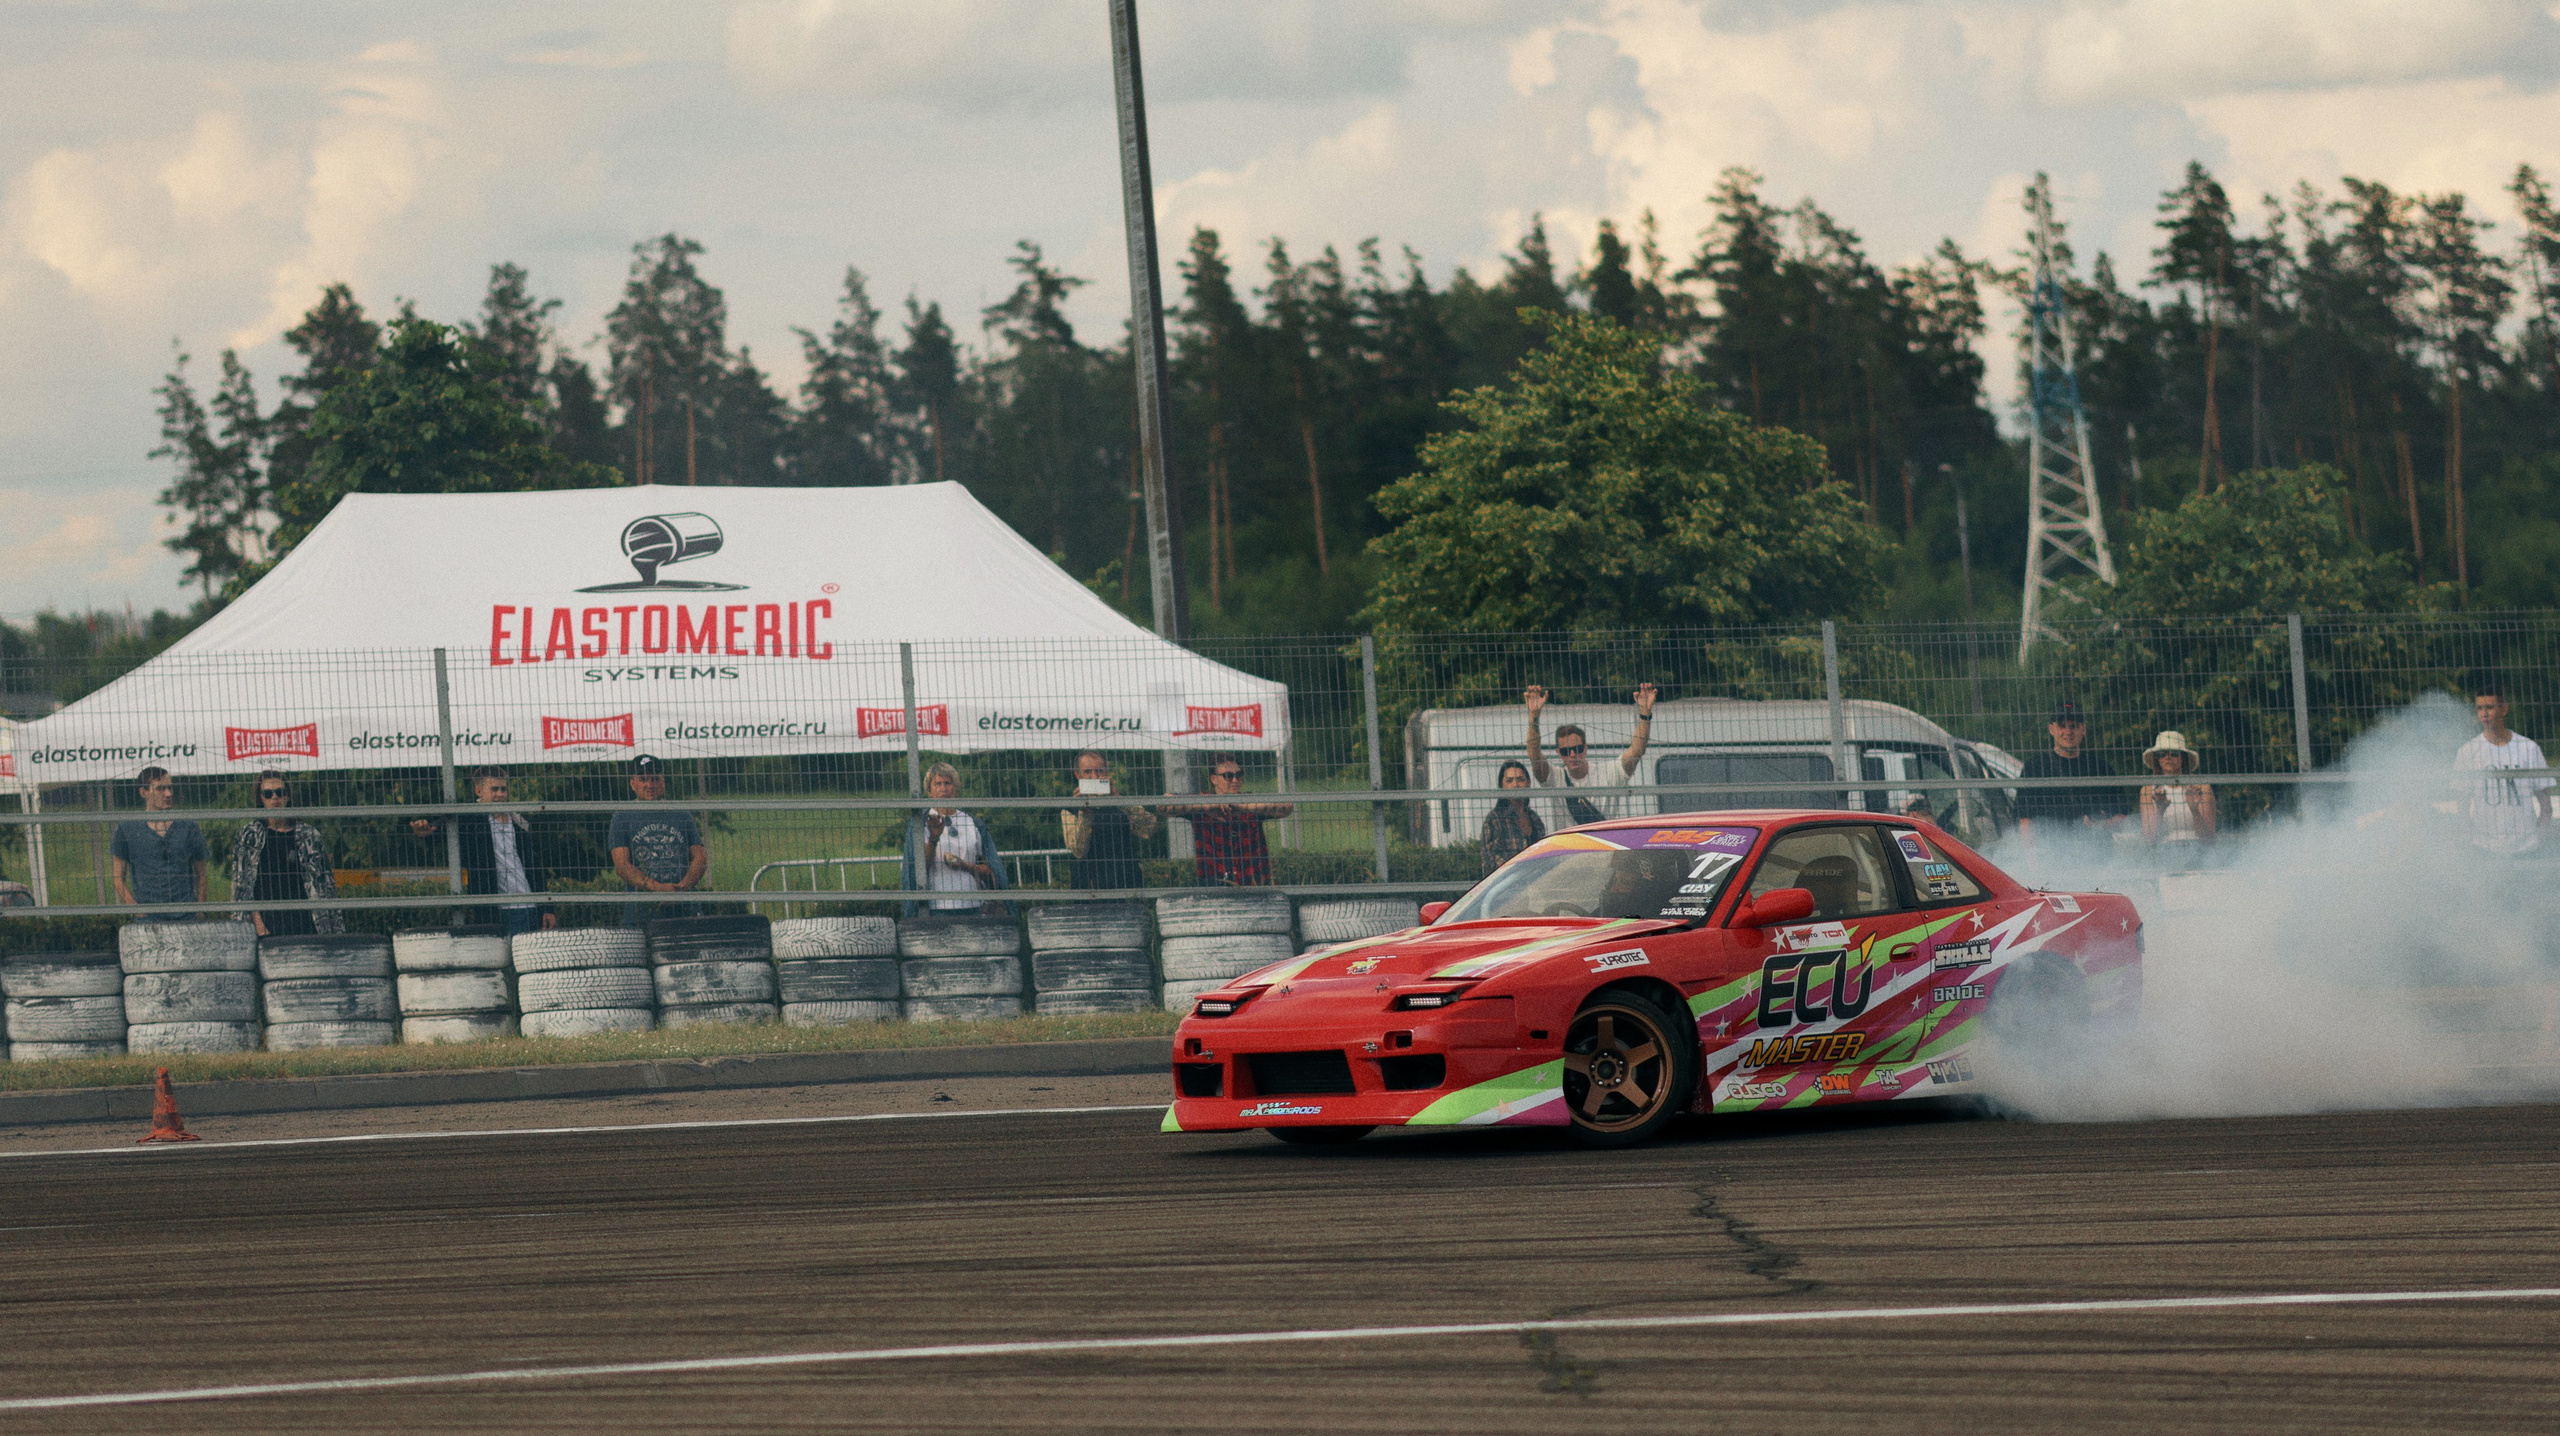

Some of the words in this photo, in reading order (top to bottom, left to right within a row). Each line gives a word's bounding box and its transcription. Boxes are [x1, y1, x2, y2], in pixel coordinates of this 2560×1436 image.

[490, 598, 833, 667] ELASTOMERIC
[583, 666, 740, 682] SYSTEMS
[550, 718, 627, 744] ELASTOMERIC
[664, 719, 827, 740] elastomeric.ru
[864, 707, 940, 733] ELASTOERIC
[978, 712, 1141, 731] elastomeric.ru
[1188, 709, 1255, 732] LASTOMERIC
[232, 729, 311, 756] ELASTOMERIC
[349, 729, 512, 750] elastomric.ru
[31, 741, 196, 764] elastomeric.ru
[1647, 830, 1723, 844] DBS
[1688, 852, 1744, 879] 17
[1599, 952, 1644, 965] SUPROTEC
[1757, 931, 1877, 1028] ECU
[1933, 984, 1985, 1002] BRIDE
[1744, 1031, 1866, 1068] MASTER
[1727, 1082, 1788, 1100] CUSCO
[1820, 1074, 1851, 1090] DW
